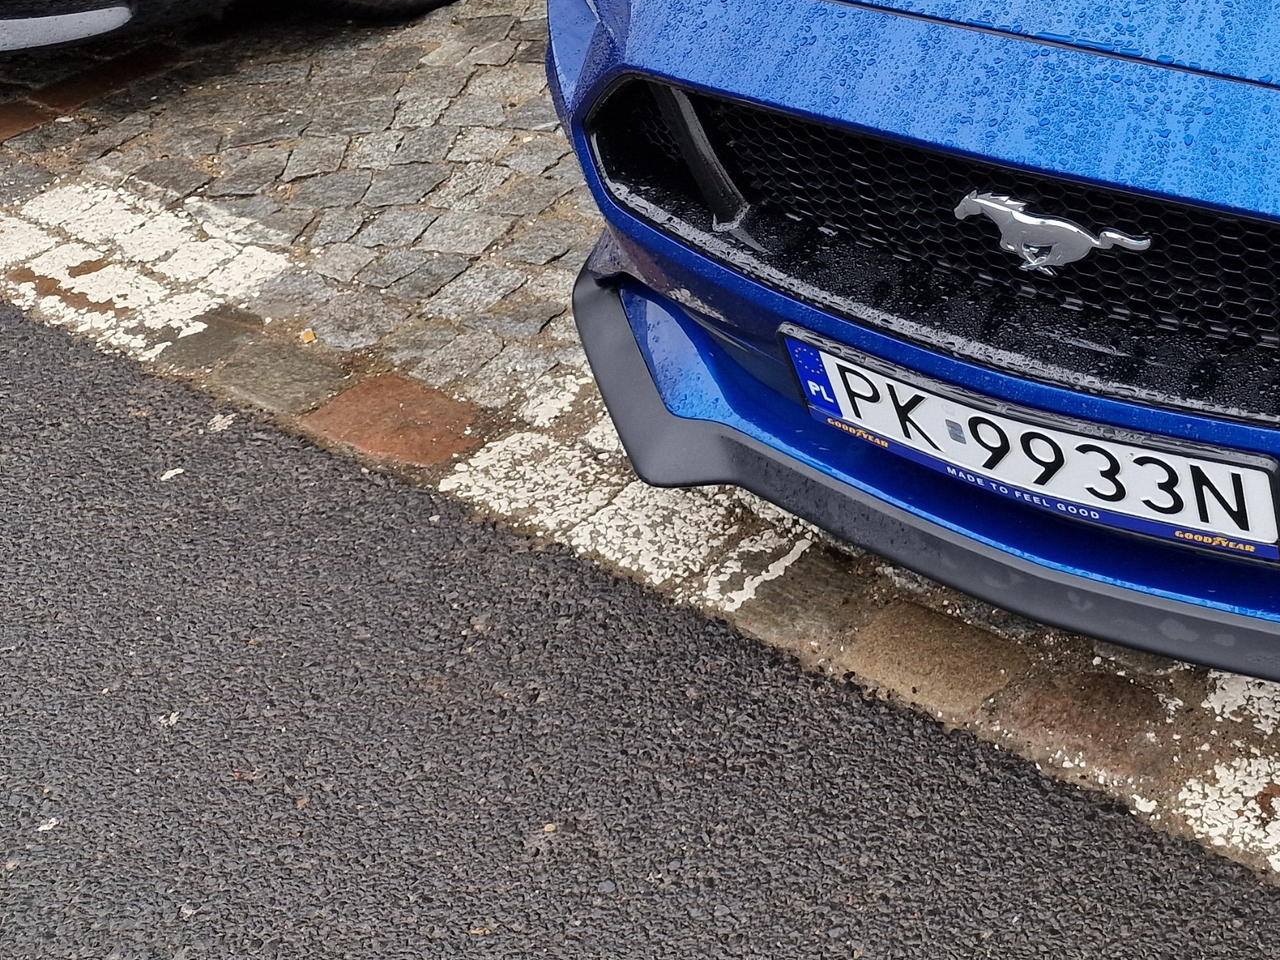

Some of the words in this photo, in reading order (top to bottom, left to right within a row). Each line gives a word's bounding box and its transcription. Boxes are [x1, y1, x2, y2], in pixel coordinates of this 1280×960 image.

[807, 380, 834, 403] PL
[827, 417, 889, 448] GOODYEAR
[835, 362, 944, 453] PK
[967, 415, 1252, 532] 9933N
[947, 466, 985, 487] MADE
[990, 482, 1009, 495] TO
[1014, 491, 1051, 507] FEEL
[1057, 503, 1100, 519] GOOD
[1174, 530, 1256, 553] GOODYEAR
